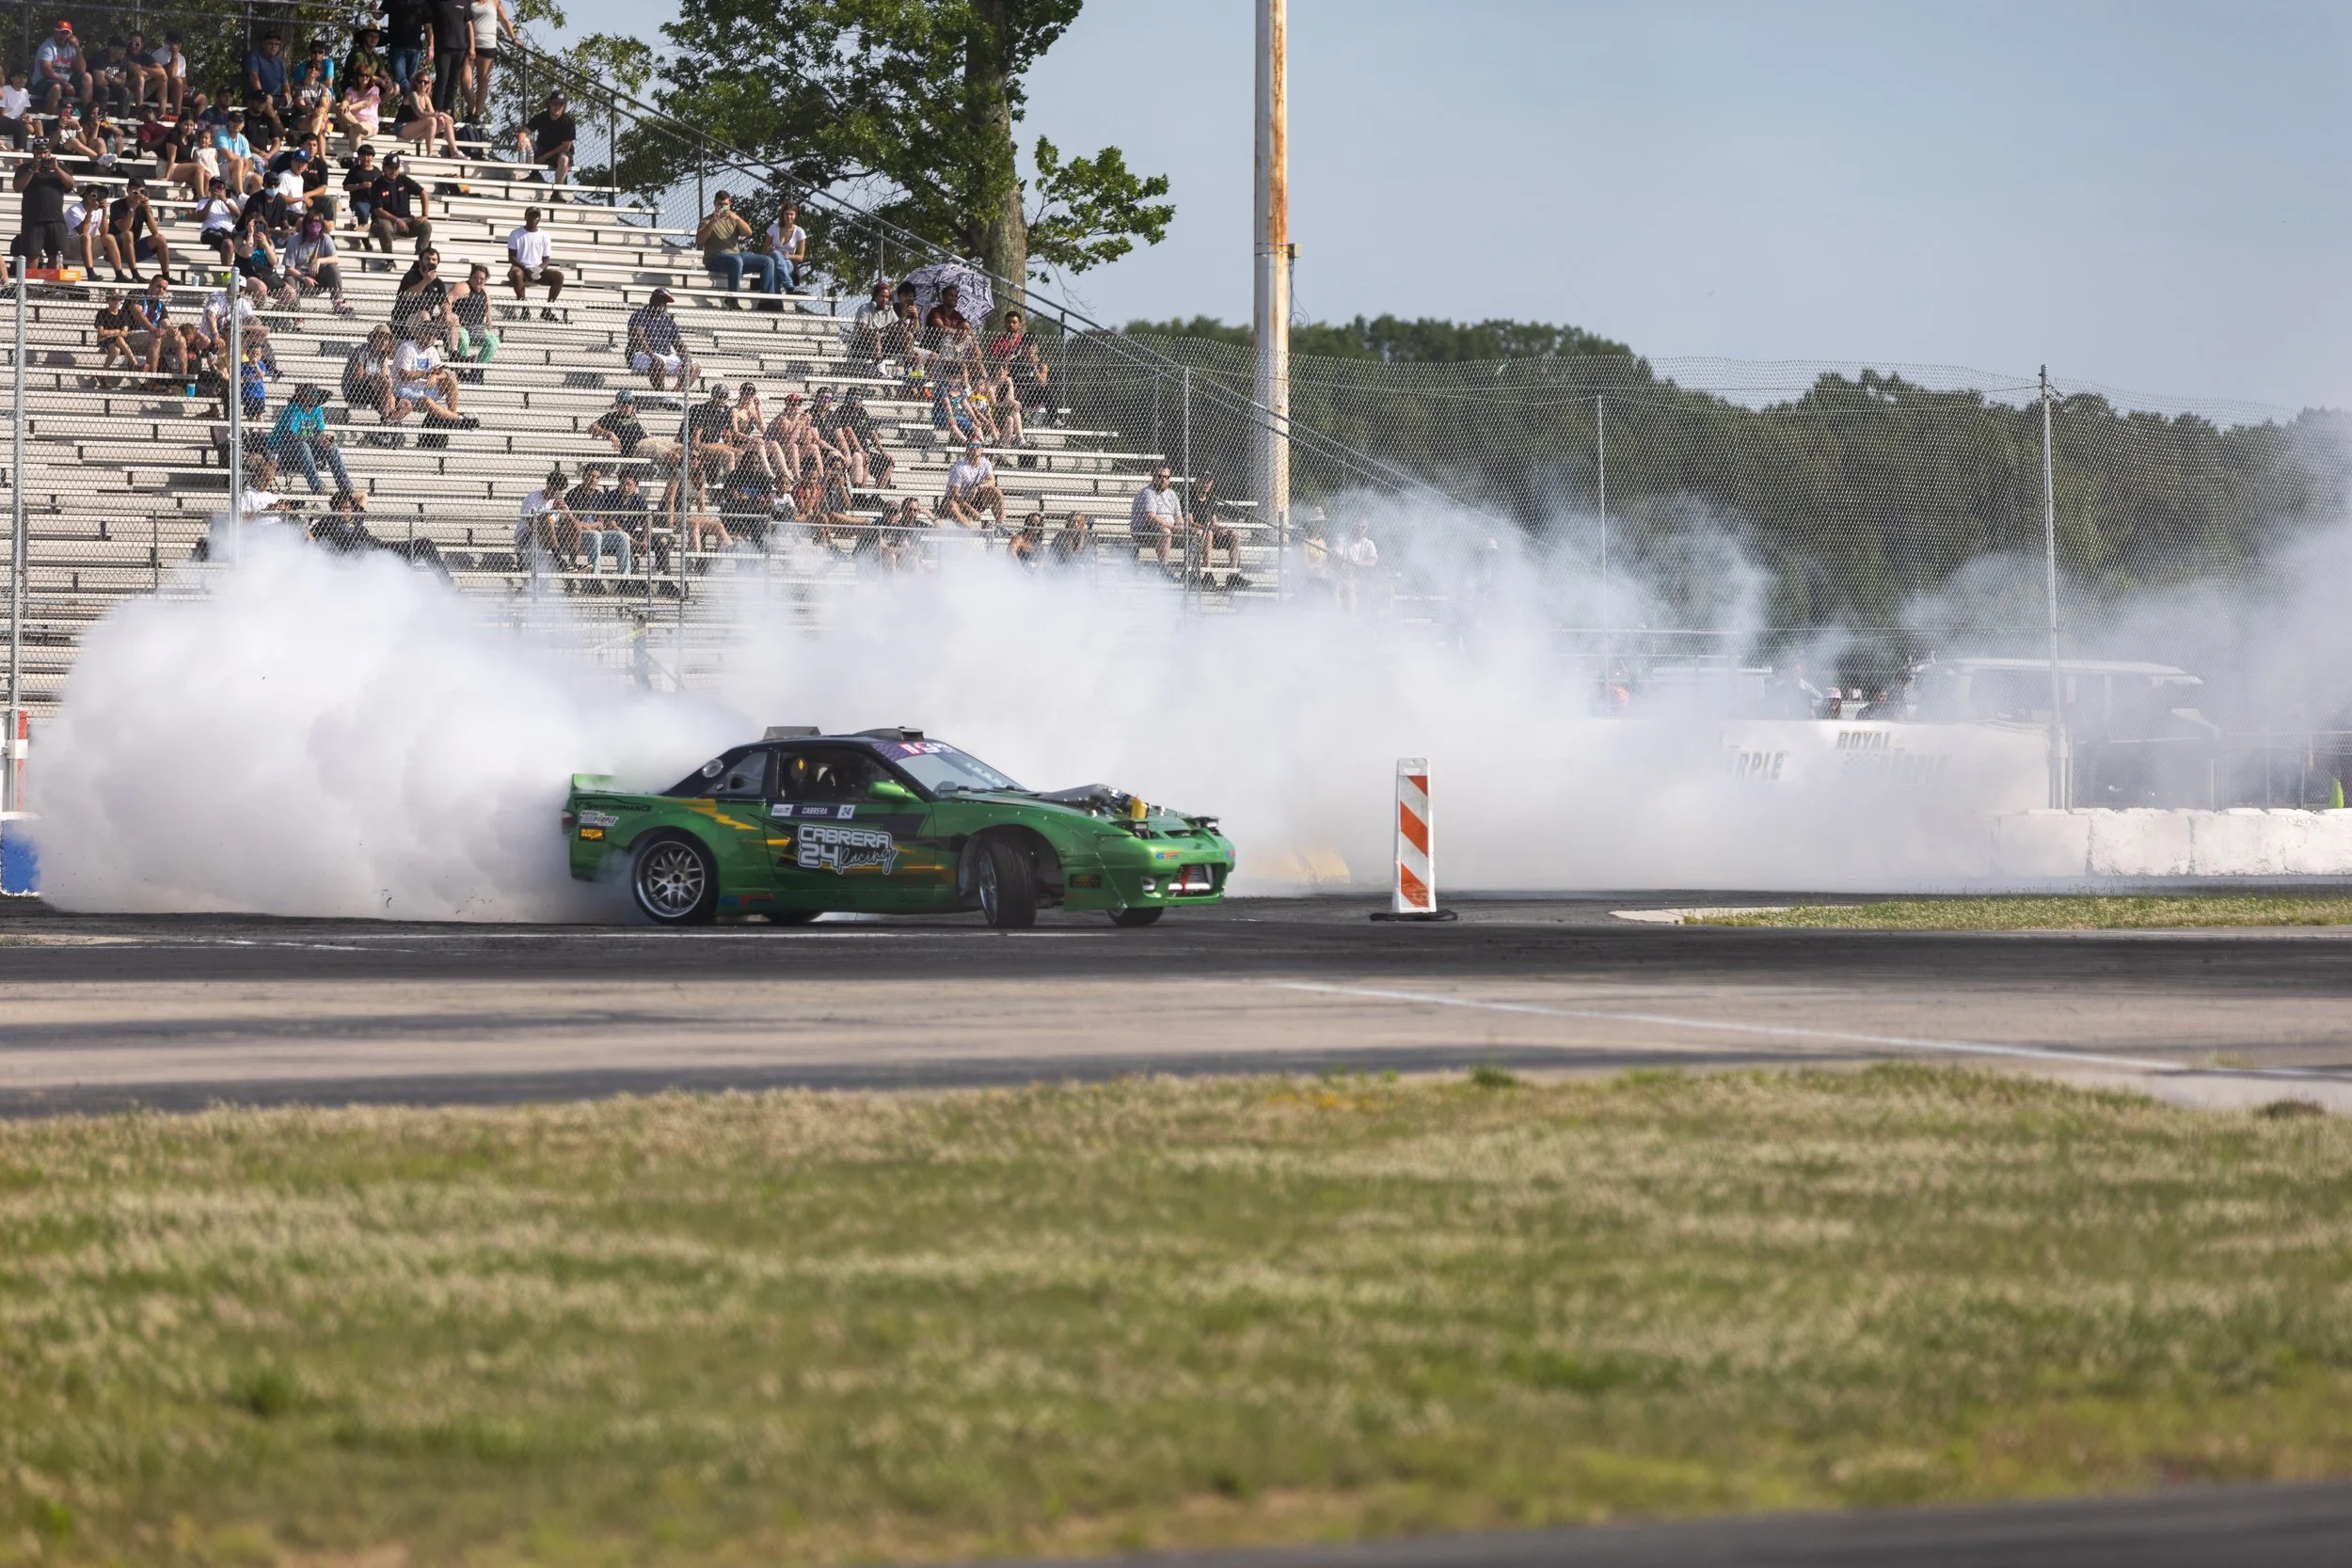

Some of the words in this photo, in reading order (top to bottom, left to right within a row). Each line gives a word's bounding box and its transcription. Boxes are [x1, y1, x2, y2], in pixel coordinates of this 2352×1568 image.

[1836, 730, 1891, 751] ROYAL
[1732, 752, 1786, 781] RPLE
[802, 806, 828, 816] CABRERA
[841, 805, 851, 816] 24
[799, 826, 890, 849] CABRERA
[799, 843, 840, 868] 24
[838, 846, 898, 874] Racing
